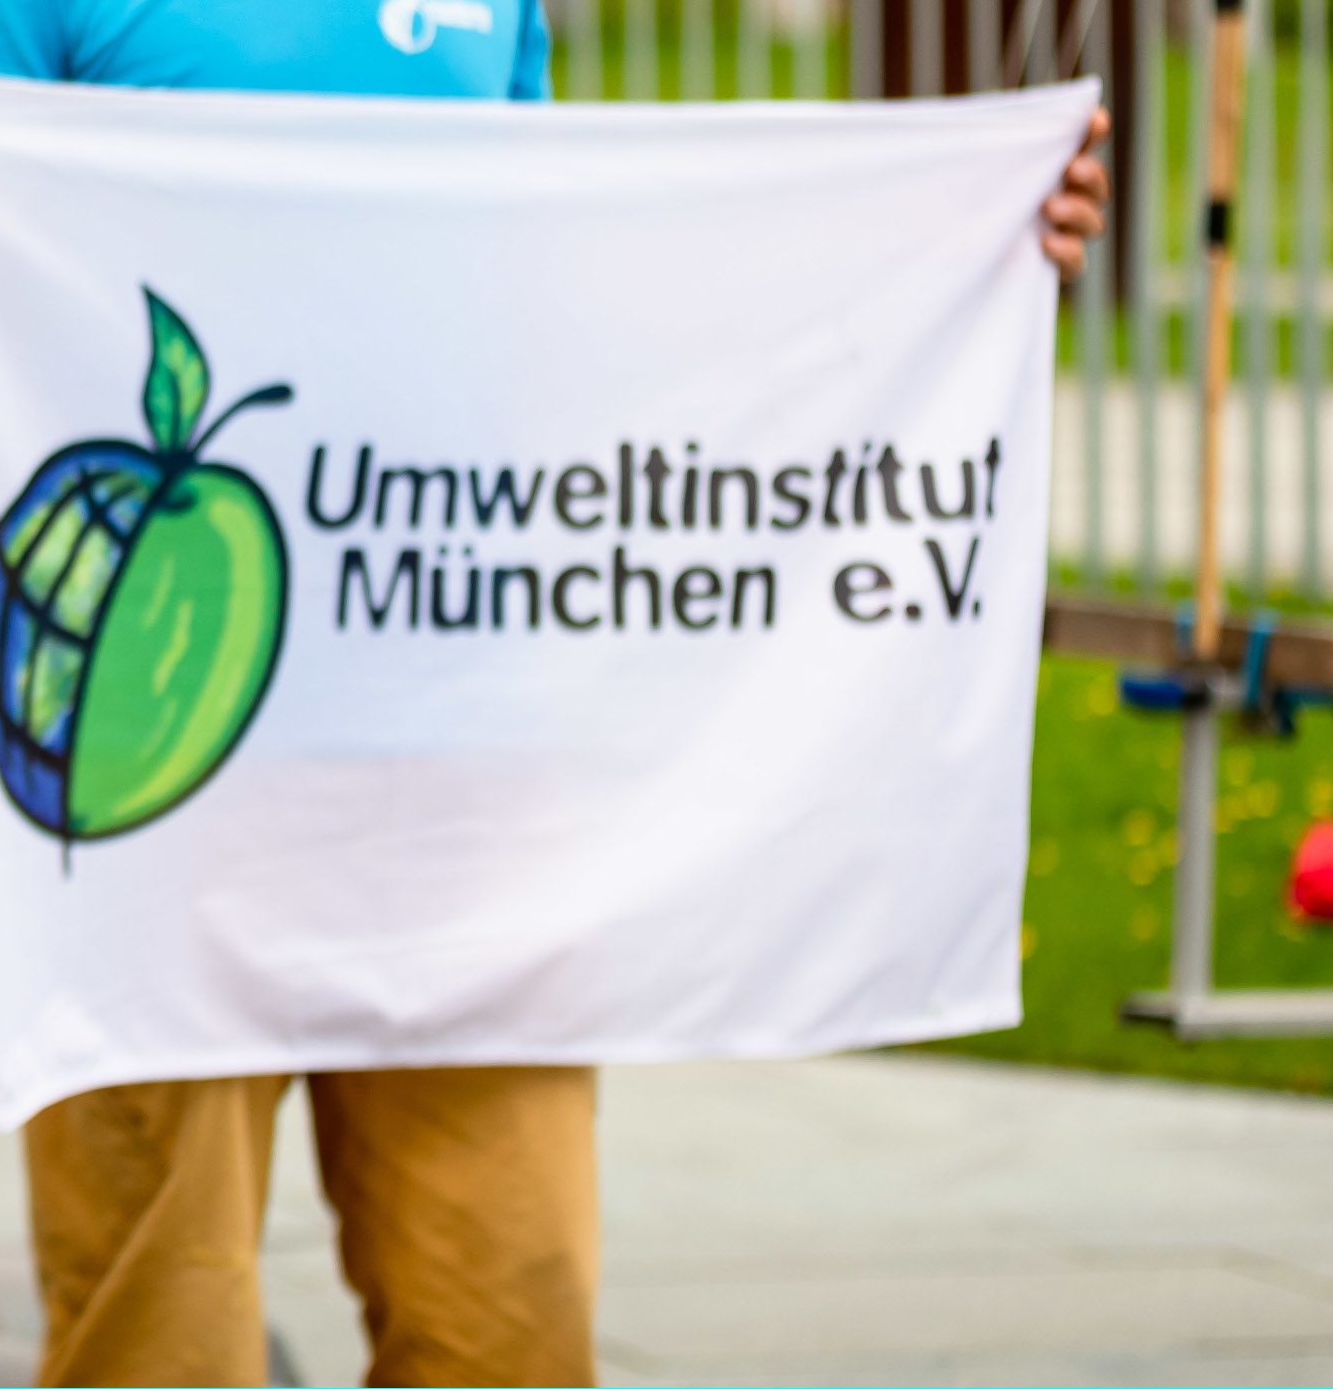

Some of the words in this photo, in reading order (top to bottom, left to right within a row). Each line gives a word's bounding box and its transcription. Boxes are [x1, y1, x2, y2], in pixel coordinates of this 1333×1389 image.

[304, 436, 1003, 532] Umweltinstitut
[336, 545, 778, 633] München
[831, 536, 983, 623] e.V.
